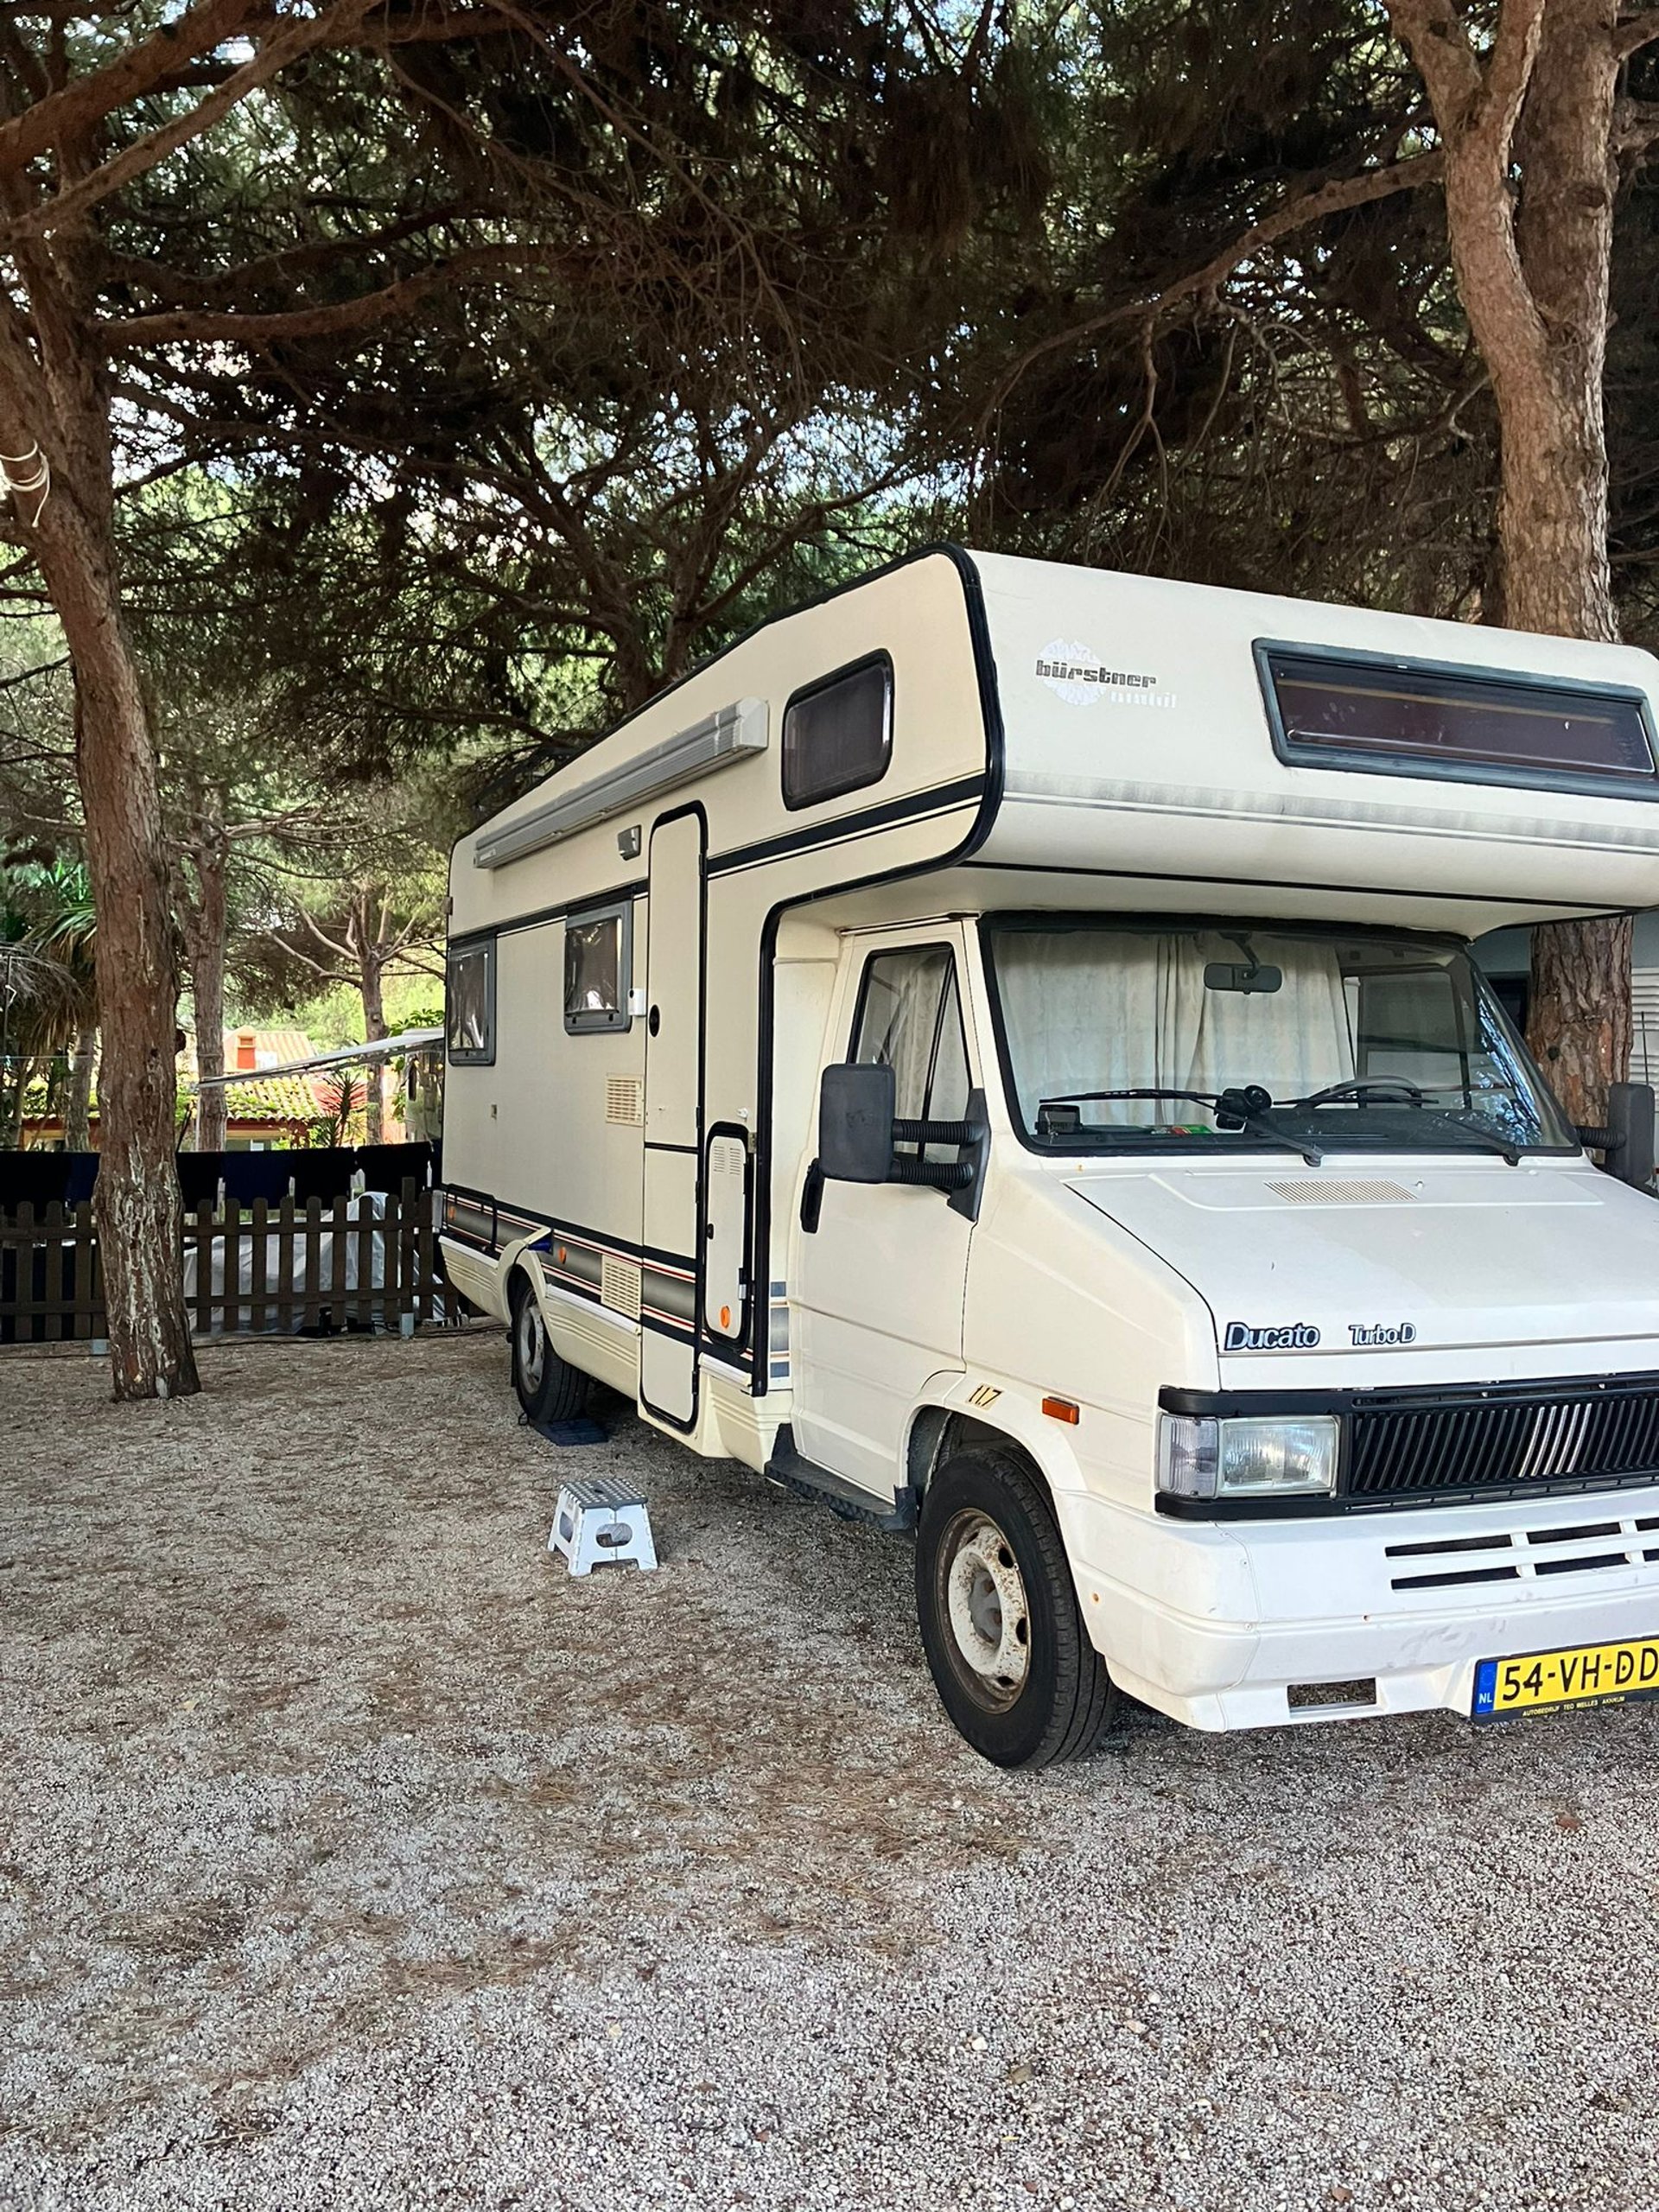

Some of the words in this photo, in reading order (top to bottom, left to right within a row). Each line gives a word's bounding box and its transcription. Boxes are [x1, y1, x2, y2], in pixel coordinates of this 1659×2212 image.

[1036, 659, 1157, 688] bürstner
[1224, 1322, 1321, 1351] Ducato
[1503, 1647, 1659, 1701] 54-VH-DD
[1478, 1693, 1493, 1704] NL
